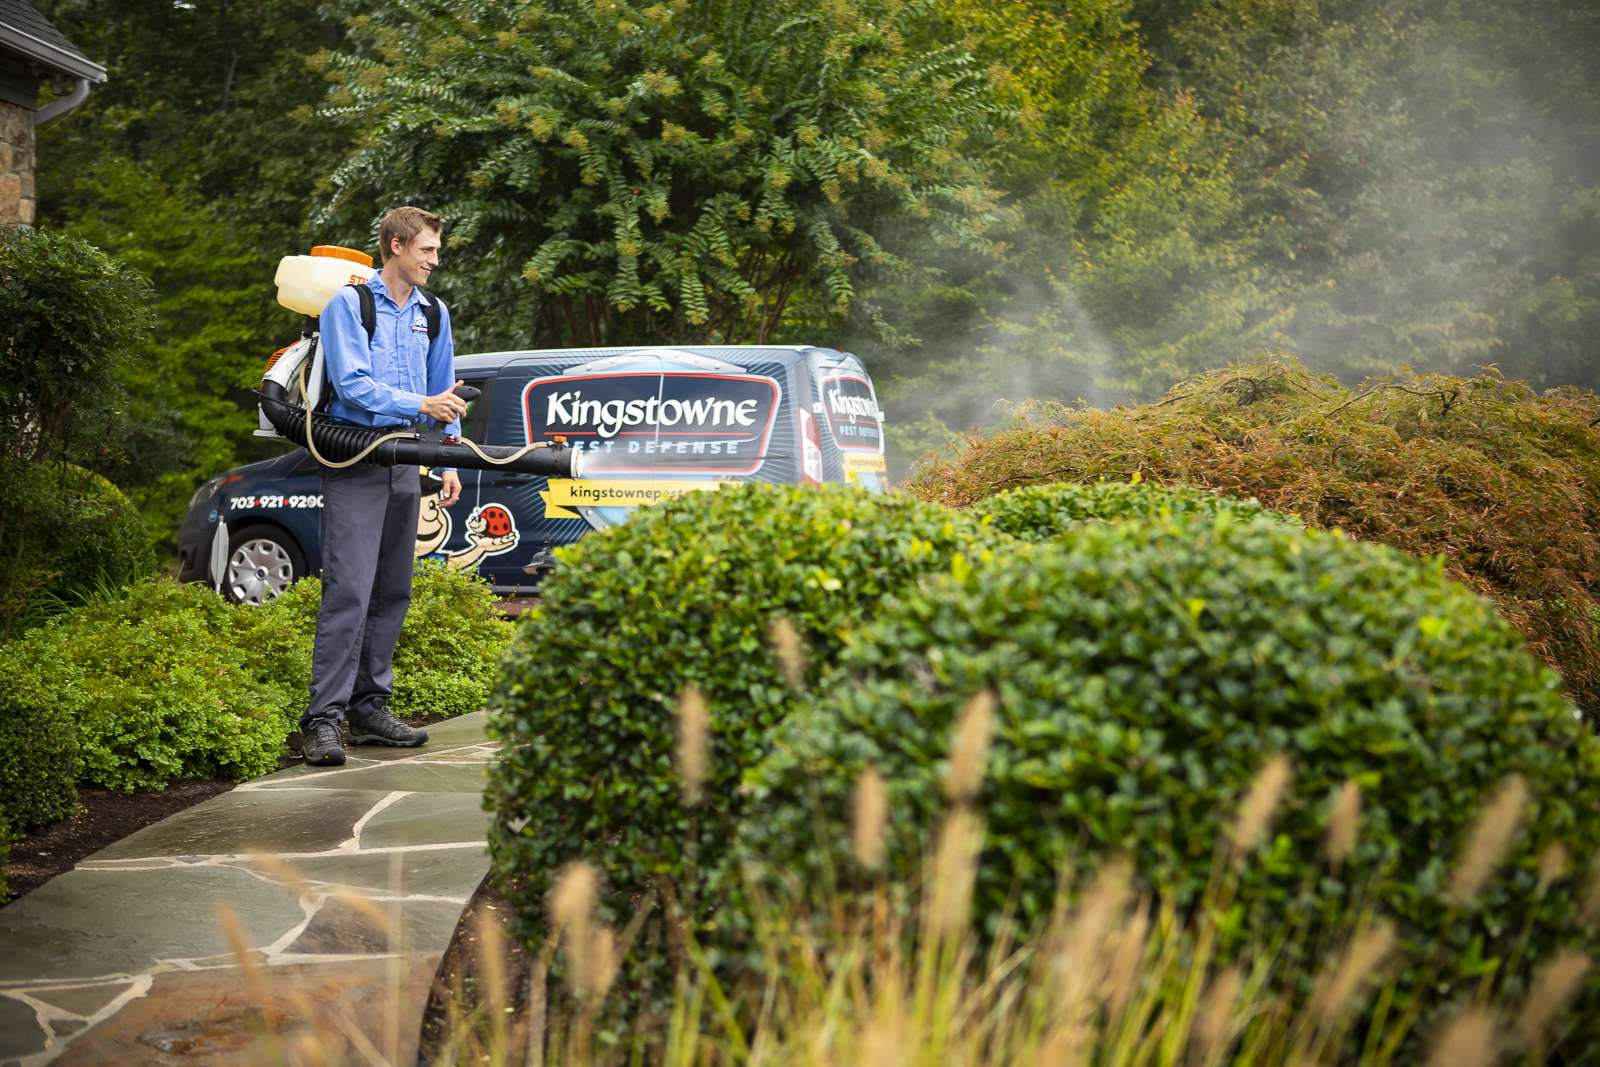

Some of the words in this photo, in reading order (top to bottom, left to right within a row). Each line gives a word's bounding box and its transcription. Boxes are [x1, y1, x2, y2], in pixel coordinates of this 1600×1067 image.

[546, 390, 759, 438] Kingstowne
[562, 440, 614, 454] EST
[628, 440, 739, 454] DEFENSE
